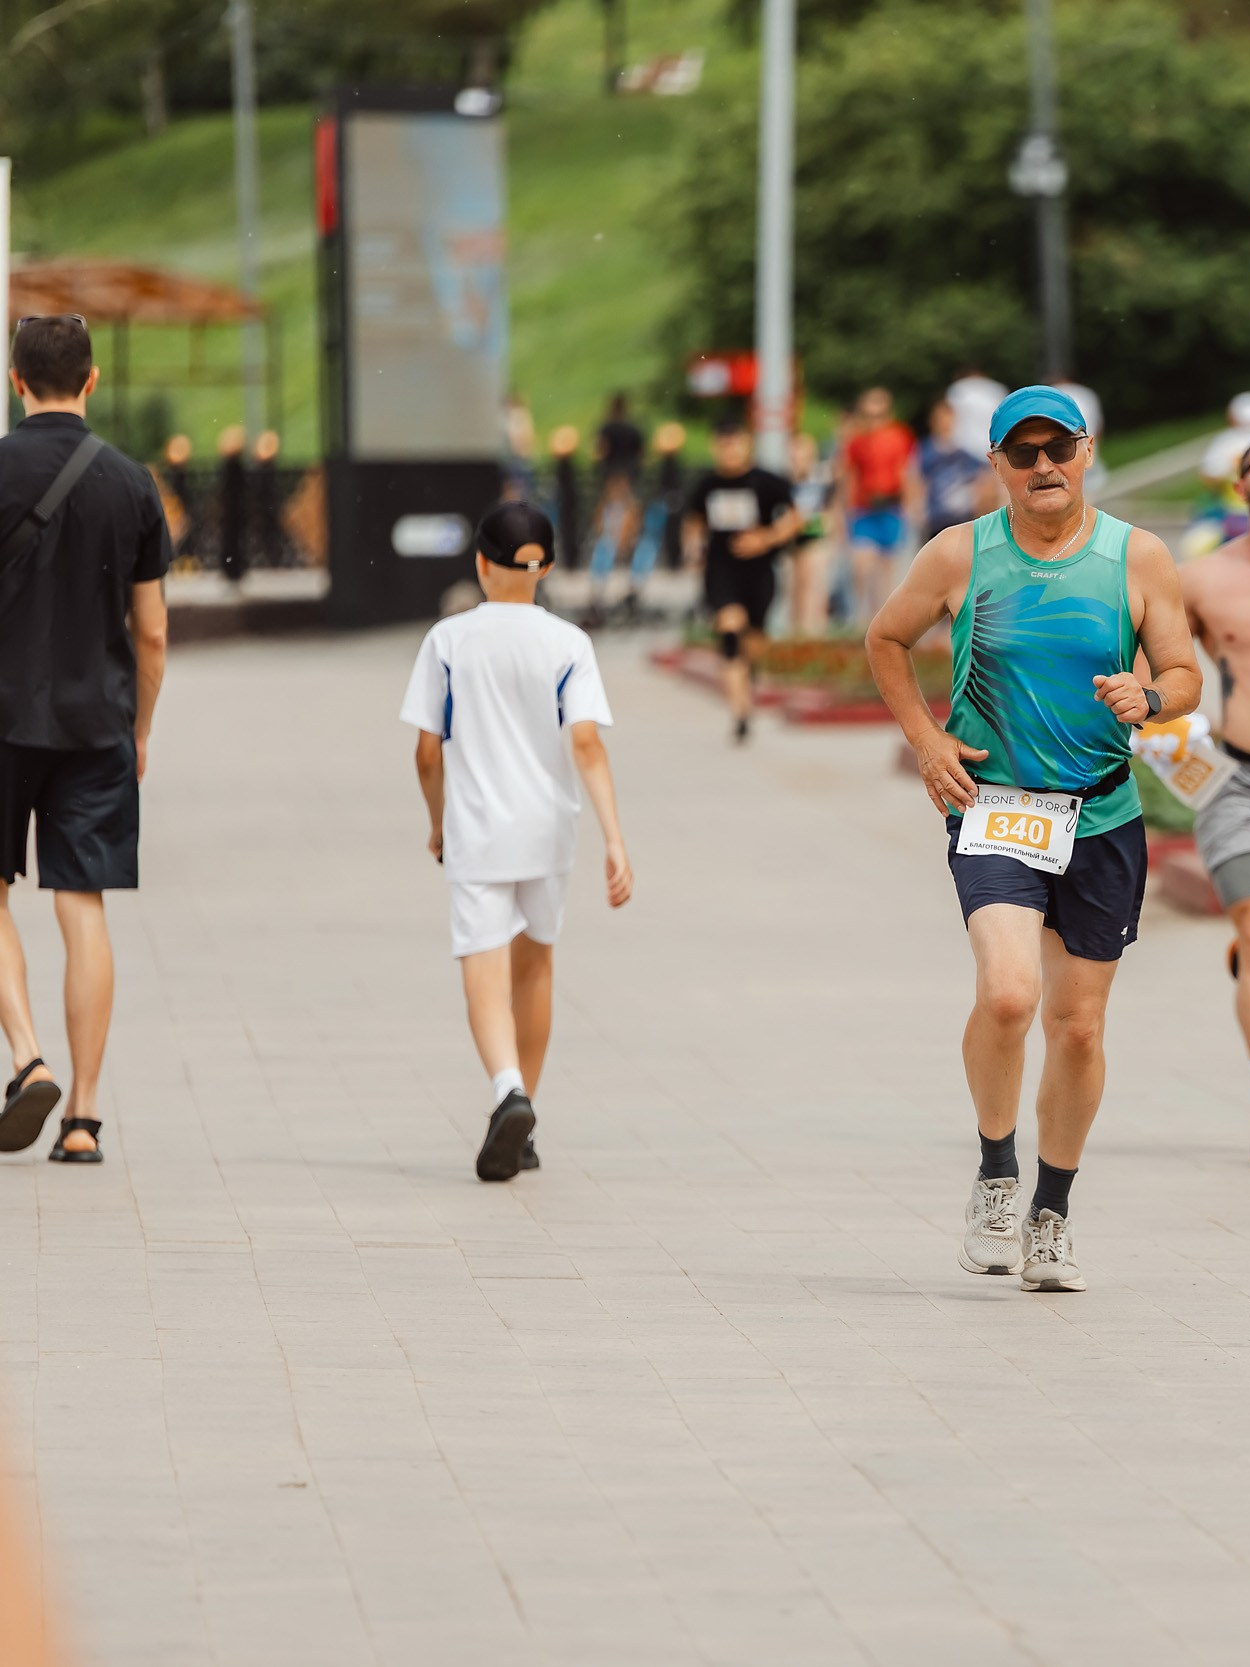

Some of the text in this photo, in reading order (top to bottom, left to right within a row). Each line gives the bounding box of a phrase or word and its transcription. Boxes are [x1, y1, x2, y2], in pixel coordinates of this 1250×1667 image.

[1030, 571, 1059, 579] CRAFT
[977, 795, 1069, 814] LEONE D'ORO
[992, 815, 1045, 845] 340
[969, 842, 1059, 865] БЛАГОТВОРИТЕЛЬНЫЙ ЗАБЕГ
